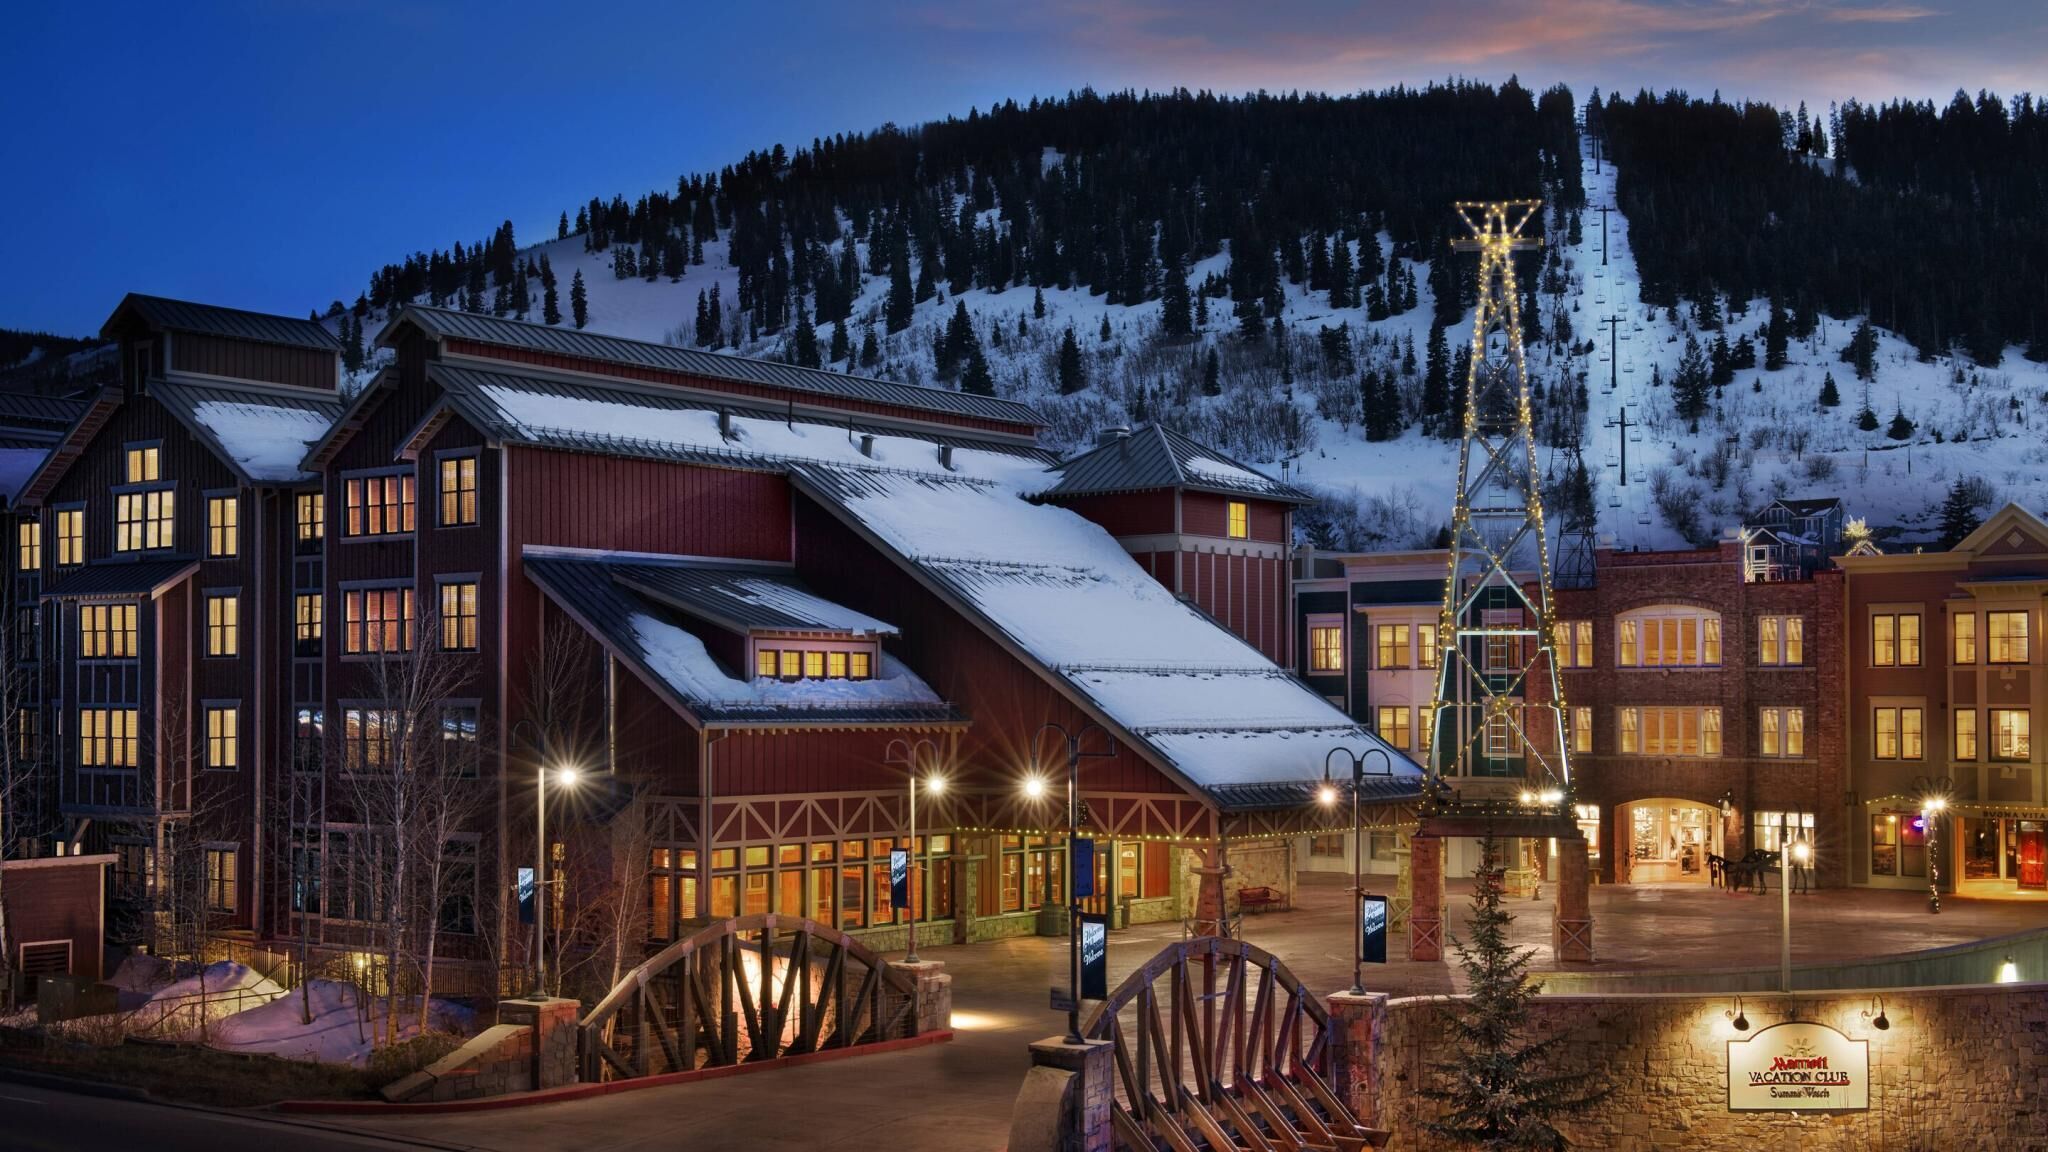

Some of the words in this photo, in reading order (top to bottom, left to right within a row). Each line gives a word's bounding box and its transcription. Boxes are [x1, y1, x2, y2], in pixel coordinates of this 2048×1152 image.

[1083, 950, 1104, 966] Welcome
[1749, 1072, 1812, 1082] VACATION
[1815, 1072, 1848, 1082] CLUB
